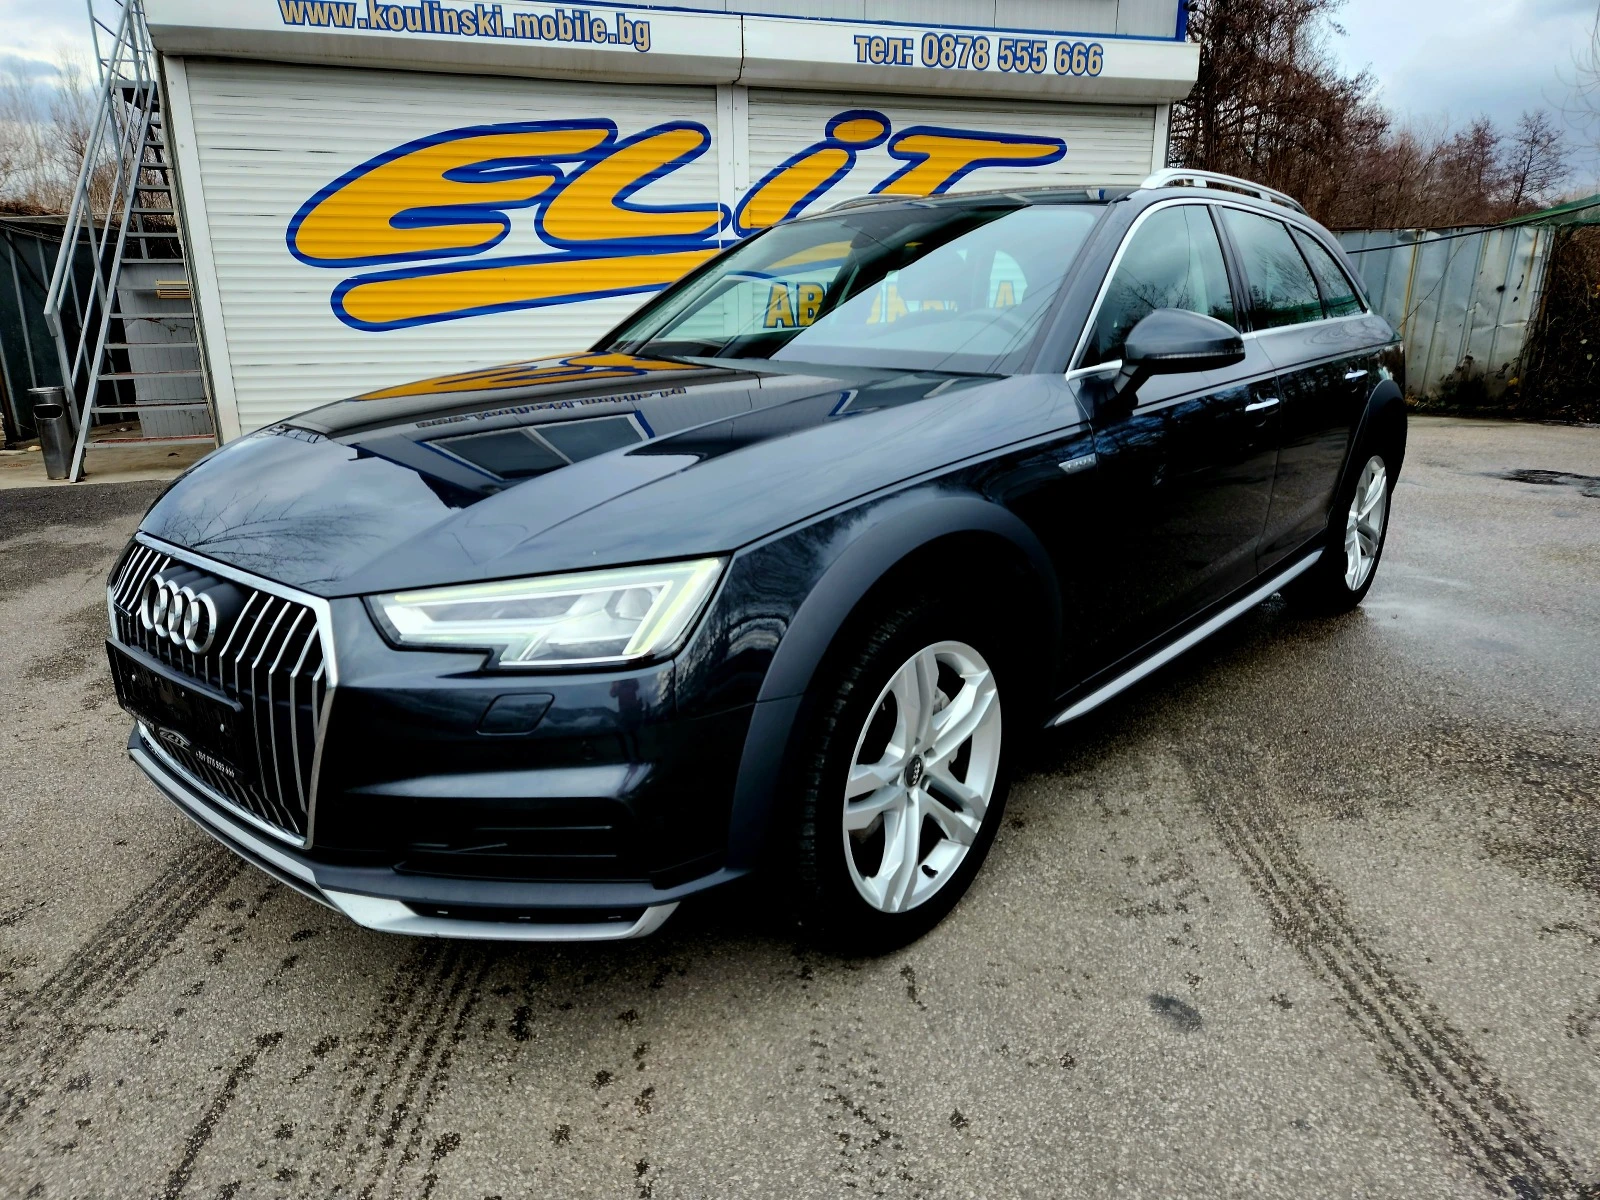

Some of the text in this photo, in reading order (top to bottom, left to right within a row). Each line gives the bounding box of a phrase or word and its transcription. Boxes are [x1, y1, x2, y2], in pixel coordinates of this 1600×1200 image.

[278, 0, 651, 53] www.koulinski.mobile.bg
[853, 32, 1104, 77] тел: 0878 555 666
